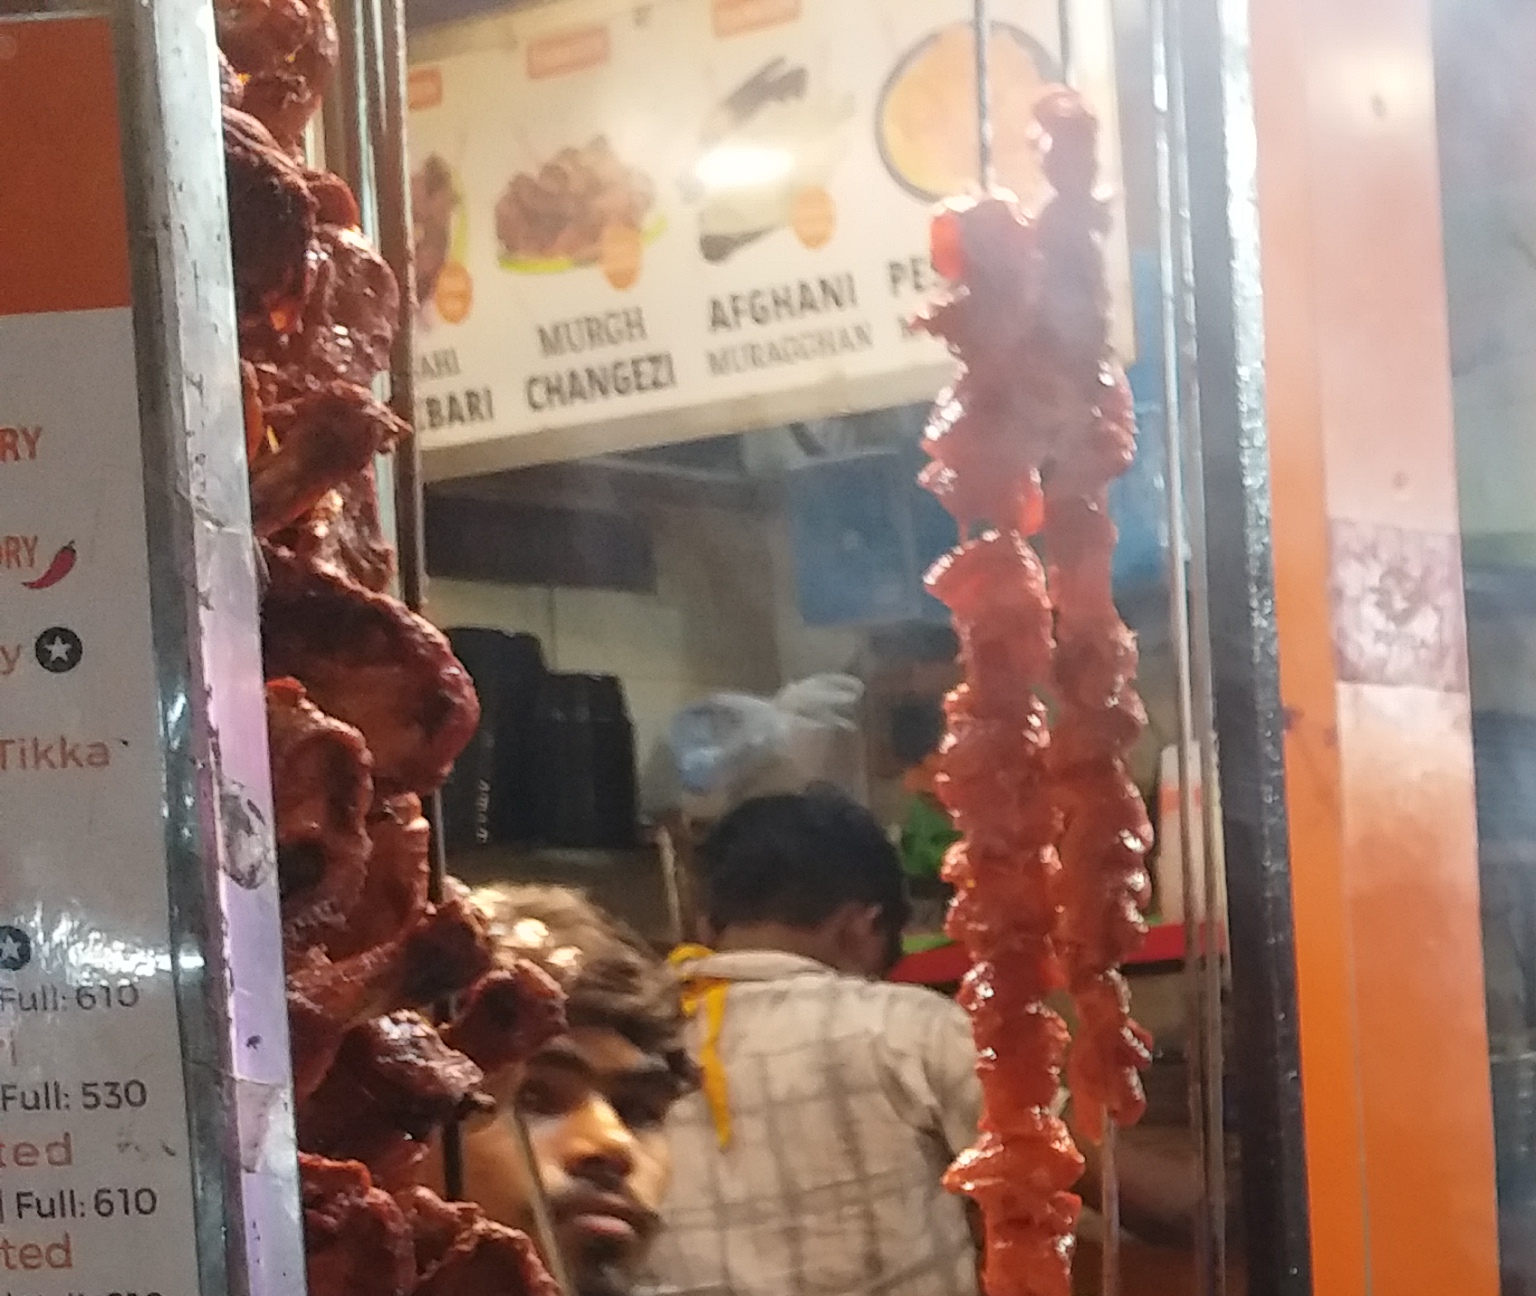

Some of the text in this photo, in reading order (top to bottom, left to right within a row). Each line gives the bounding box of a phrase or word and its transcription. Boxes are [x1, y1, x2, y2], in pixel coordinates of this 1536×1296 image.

[707, 272, 859, 333] AFGHANI
[887, 256, 941, 297] PE
[537, 306, 648, 359] MURGH
[419, 349, 462, 378] AHI
[525, 351, 677, 412] CHANGEZI
[420, 386, 494, 431] BARI
[0, 535, 38, 568] RY
[0, 733, 110, 770] Tikka
[76, 984, 139, 1011] 610
[1, 1078, 147, 1111] Full: 530
[16, 1189, 86, 1219] Full:
[94, 1187, 157, 1217] 610
